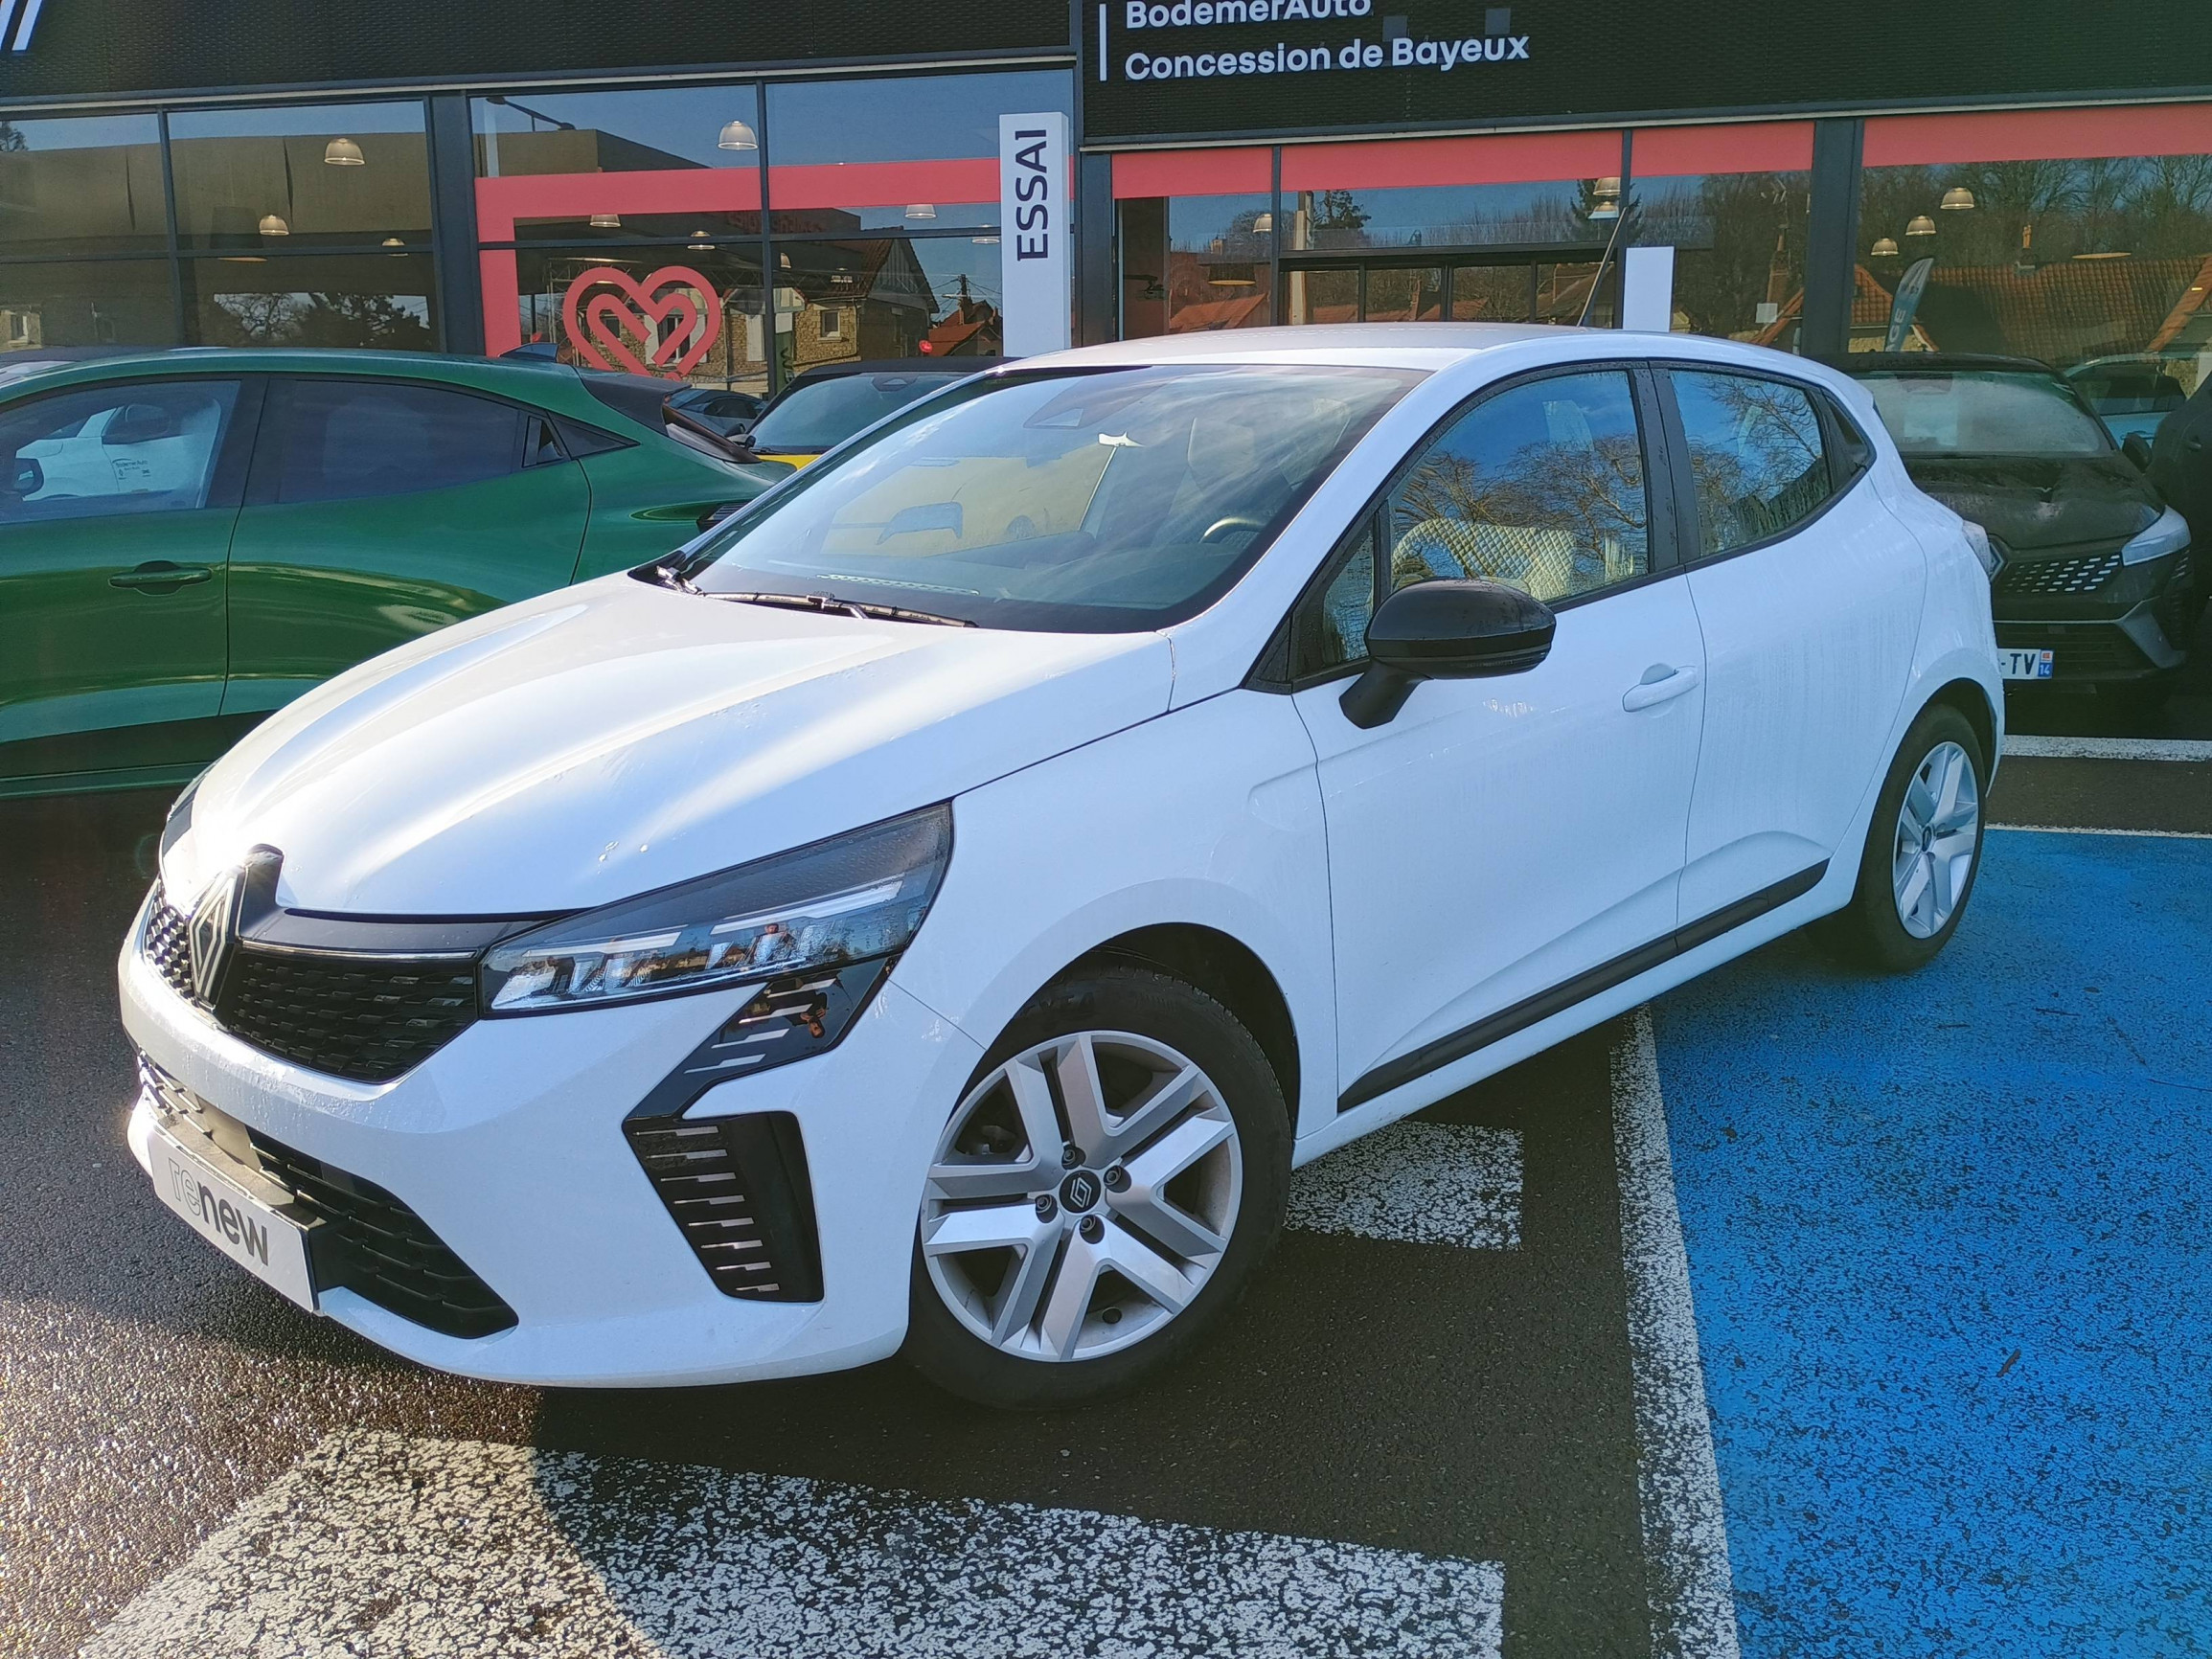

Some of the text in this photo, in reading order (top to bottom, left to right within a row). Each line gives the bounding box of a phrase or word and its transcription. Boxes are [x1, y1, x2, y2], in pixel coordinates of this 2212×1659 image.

[1126, 0, 1372, 29] BodemerAuto
[1125, 35, 1531, 80] Concession de Bayeux
[1015, 129, 1049, 261] ESSAI
[2039, 664, 2050, 675] 14
[168, 1156, 269, 1267] renew
